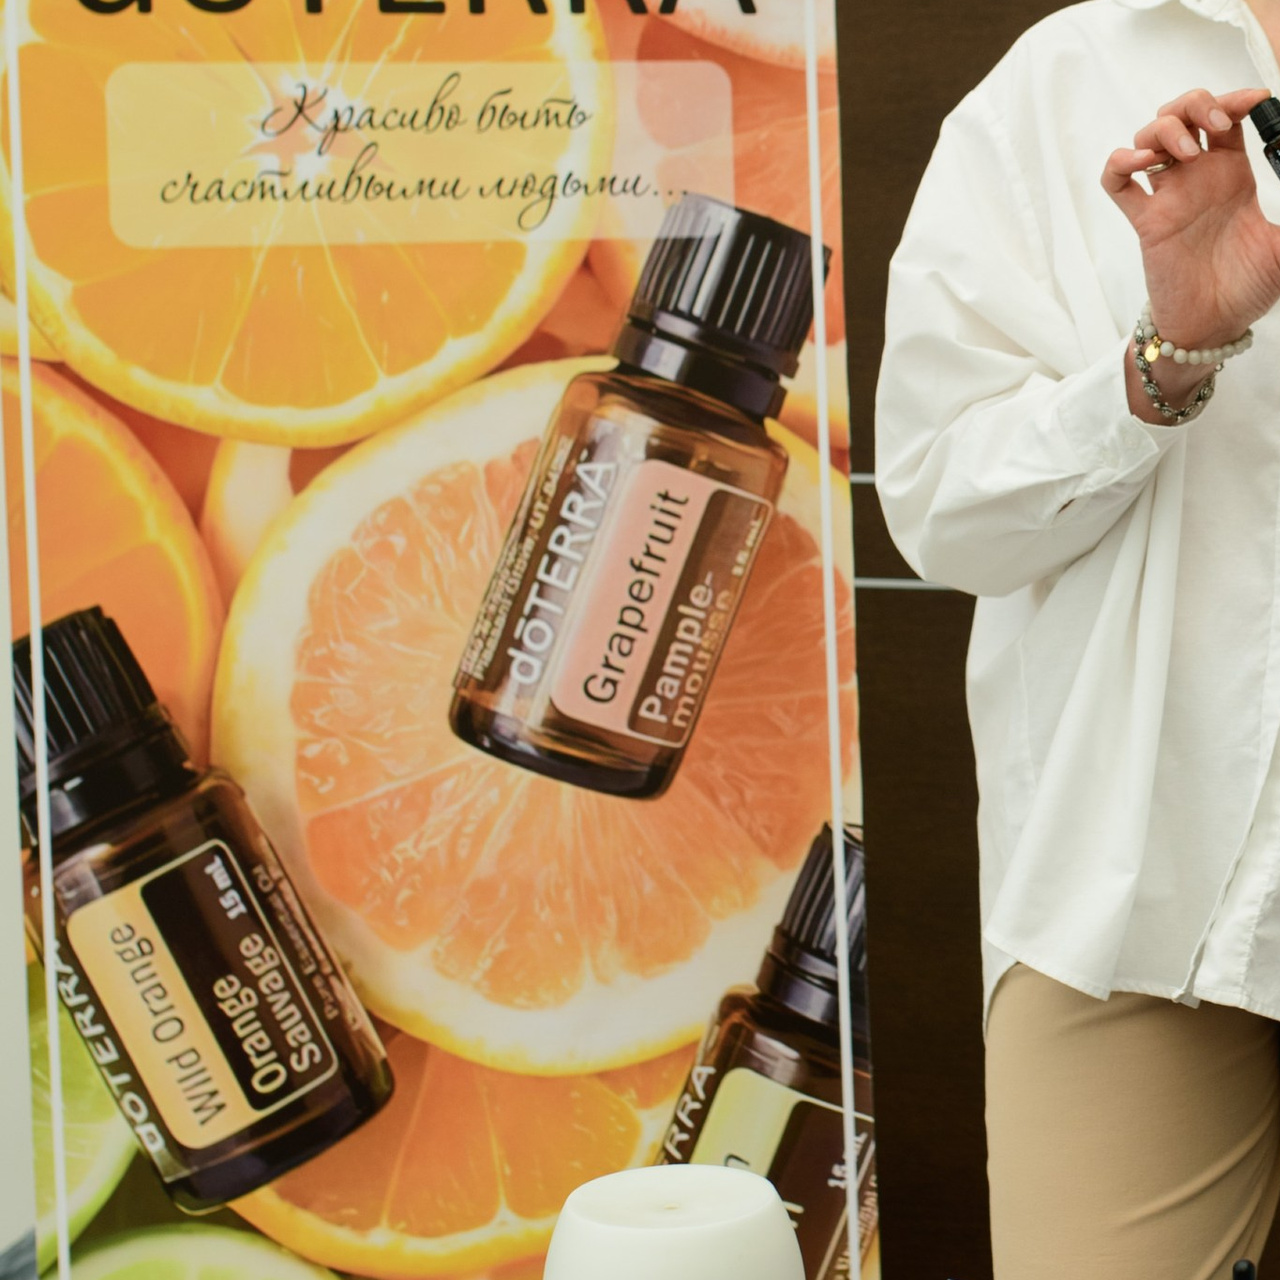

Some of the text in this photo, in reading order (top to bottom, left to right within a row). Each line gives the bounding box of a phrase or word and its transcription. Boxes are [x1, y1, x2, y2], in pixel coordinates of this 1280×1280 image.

[159, 142, 470, 206] счастливыми
[261, 72, 592, 156] Красиво быть
[585, 488, 689, 701] Grapefruit
[637, 571, 714, 722] Pample-
[219, 888, 247, 920] 15
[109, 922, 225, 1126] Wild Orange
[214, 973, 287, 1088] Orange
[238, 932, 322, 1069] Sauvage
